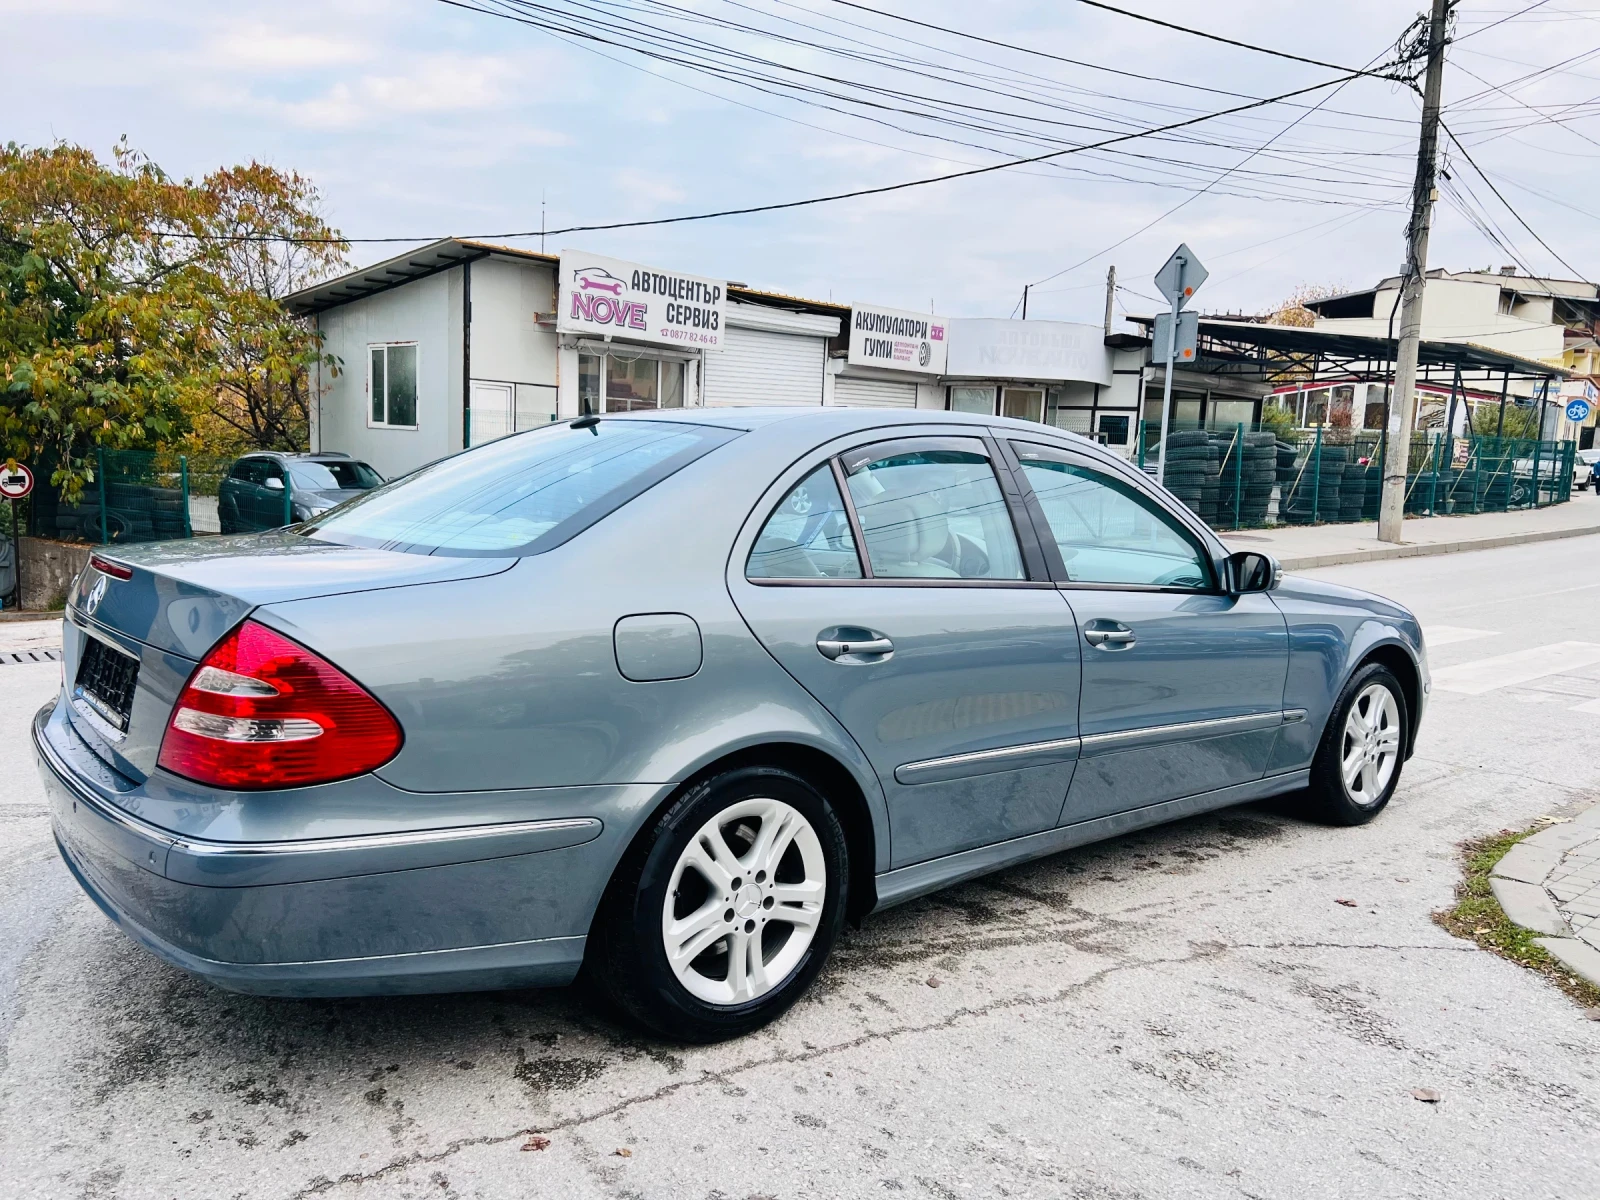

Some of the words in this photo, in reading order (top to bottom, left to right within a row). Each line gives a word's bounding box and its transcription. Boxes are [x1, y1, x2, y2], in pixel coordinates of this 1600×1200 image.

[631, 269, 721, 306] АВТОЦЕНТЪР
[570, 291, 648, 331] NOVE
[666, 302, 719, 331] СЕРВИЗ
[855, 311, 928, 339] АКУМУЛАТОРИ
[670, 329, 687, 342] 0877
[688, 332, 698, 342] 82
[698, 333, 708, 344] 46
[708, 335, 718, 345] 43
[864, 338, 893, 359] ГУМИ
